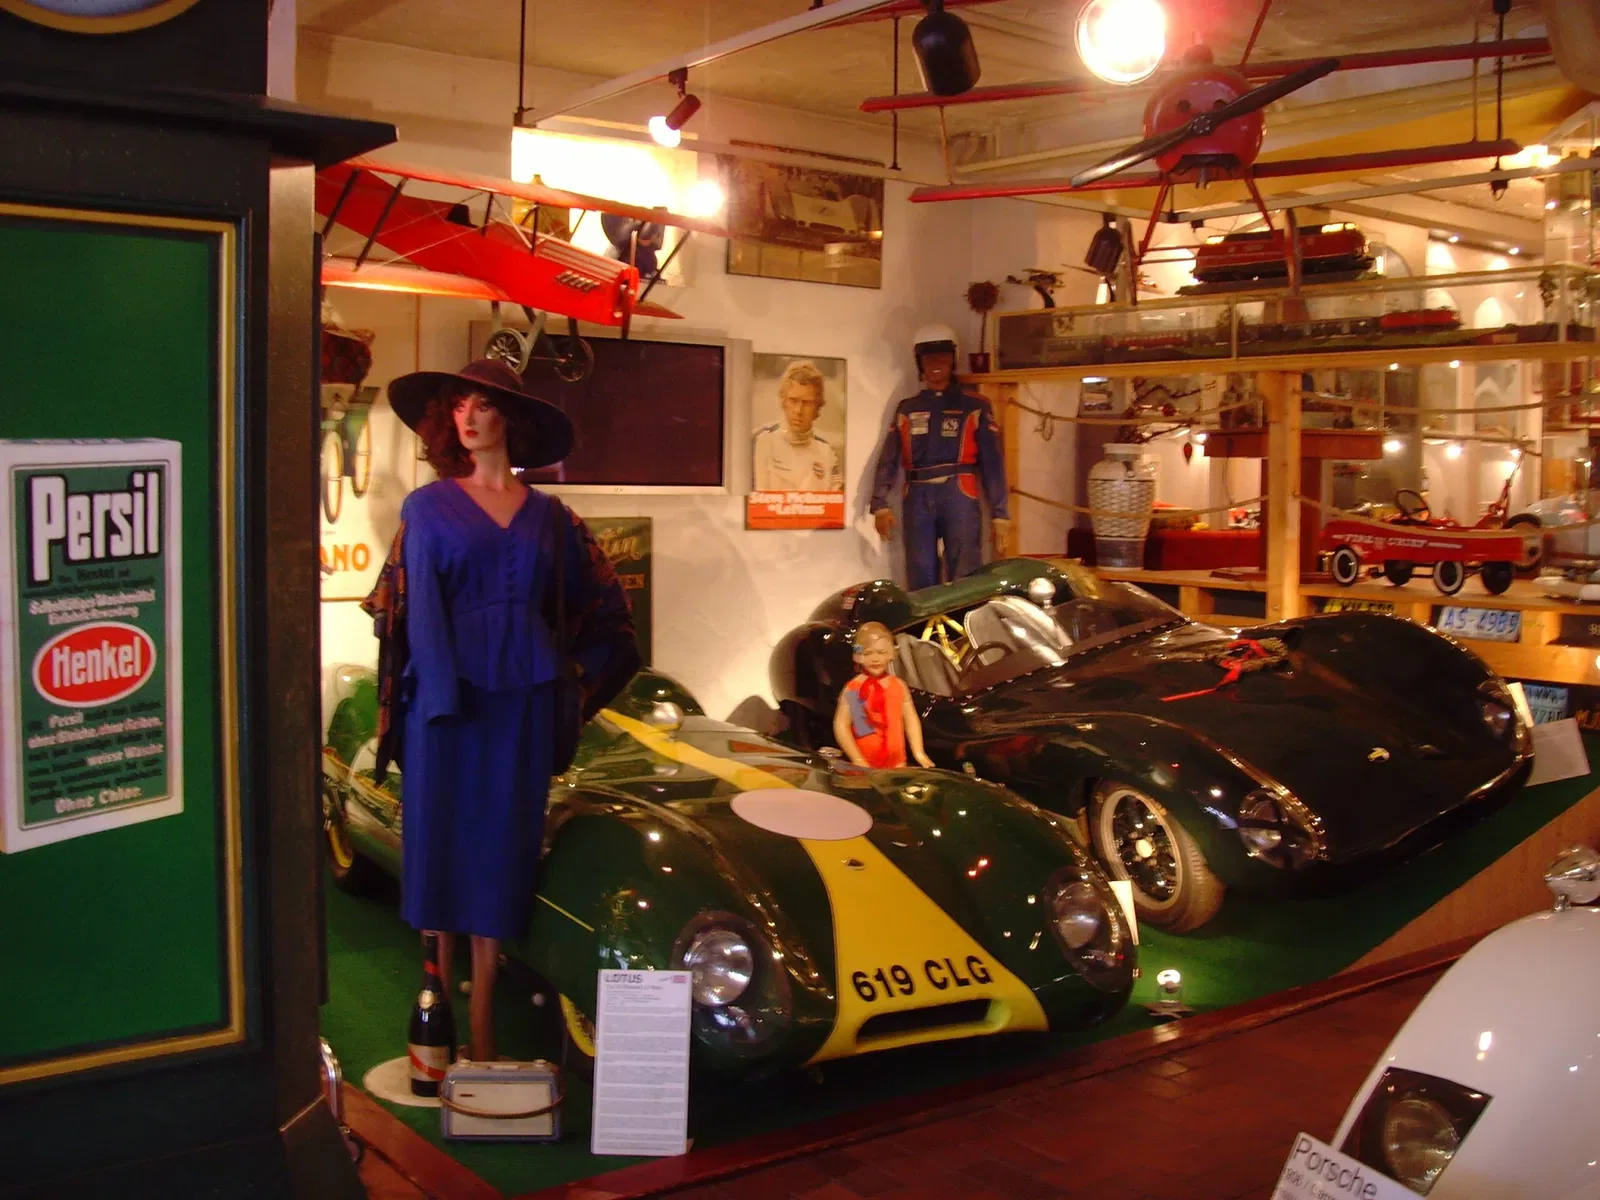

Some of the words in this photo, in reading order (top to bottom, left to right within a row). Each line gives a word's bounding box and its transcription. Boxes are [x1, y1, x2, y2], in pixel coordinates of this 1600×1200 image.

[30, 471, 160, 582] Persil
[51, 635, 142, 688] Henkel
[48, 710, 84, 728] Persil
[604, 973, 644, 984] LOTUS
[852, 964, 916, 1003] 619
[924, 955, 995, 991] CLG
[1293, 1138, 1378, 1199] Porsche
